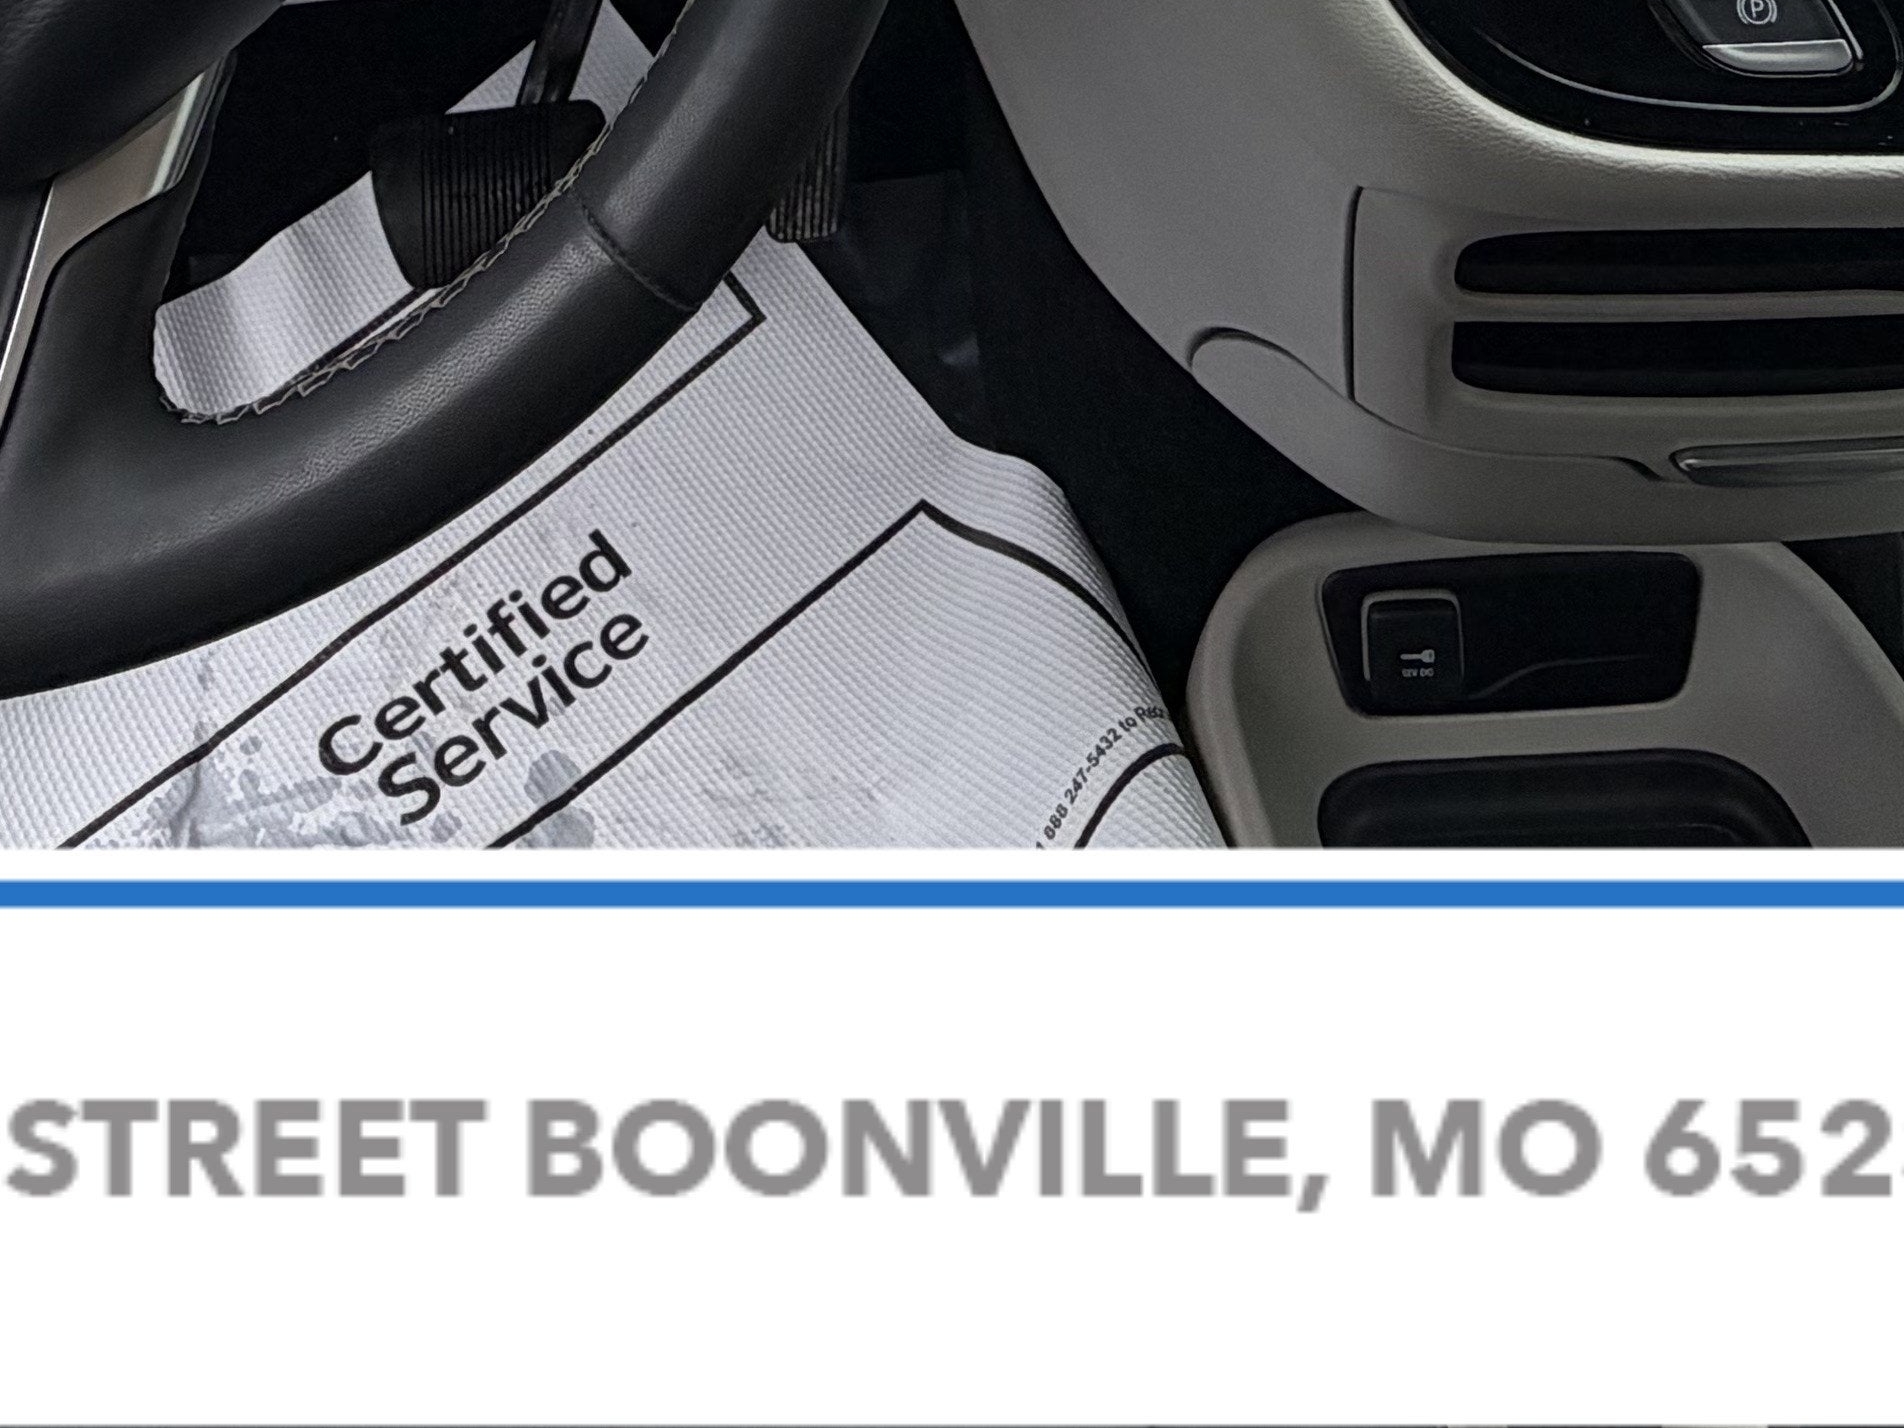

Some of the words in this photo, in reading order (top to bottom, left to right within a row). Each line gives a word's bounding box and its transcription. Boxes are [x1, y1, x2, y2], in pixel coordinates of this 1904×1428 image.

[318, 529, 632, 776] Certified
[378, 613, 650, 826] Service
[1044, 803, 1068, 840] 888
[1064, 728, 1123, 805] 247-5432
[1118, 716, 1137, 732] to
